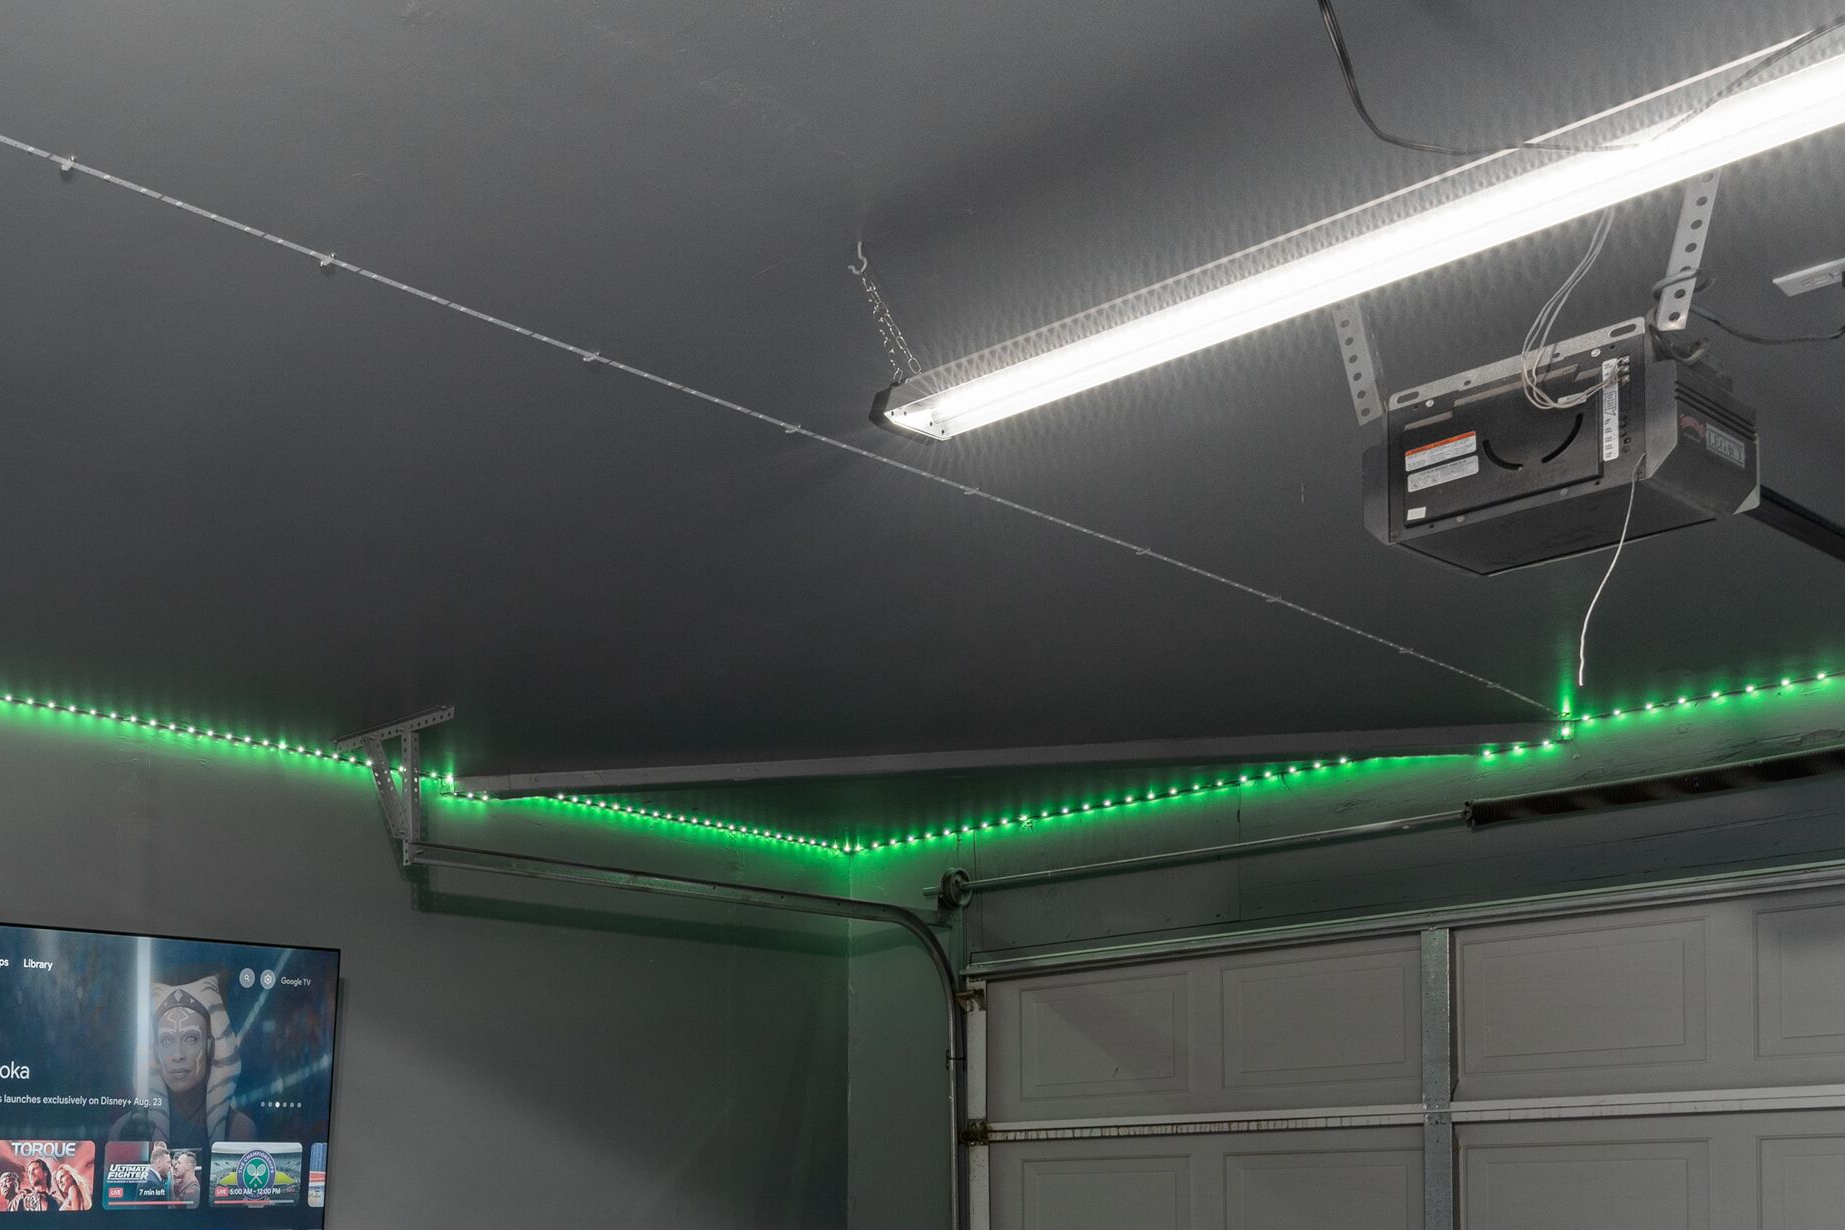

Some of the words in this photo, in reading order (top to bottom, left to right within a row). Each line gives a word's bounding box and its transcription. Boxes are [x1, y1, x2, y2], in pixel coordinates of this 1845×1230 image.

[23, 958, 53, 972] Library
[280, 976, 302, 986] Google
[4, 1094, 41, 1104] launches
[42, 1095, 86, 1106] exclusively
[101, 1096, 132, 1108] Disney+
[134, 1098, 152, 1108] Aug.
[152, 1098, 162, 1106] 23
[11, 1142, 76, 1158] TORQUE
[107, 1172, 148, 1180] FIGHTER
